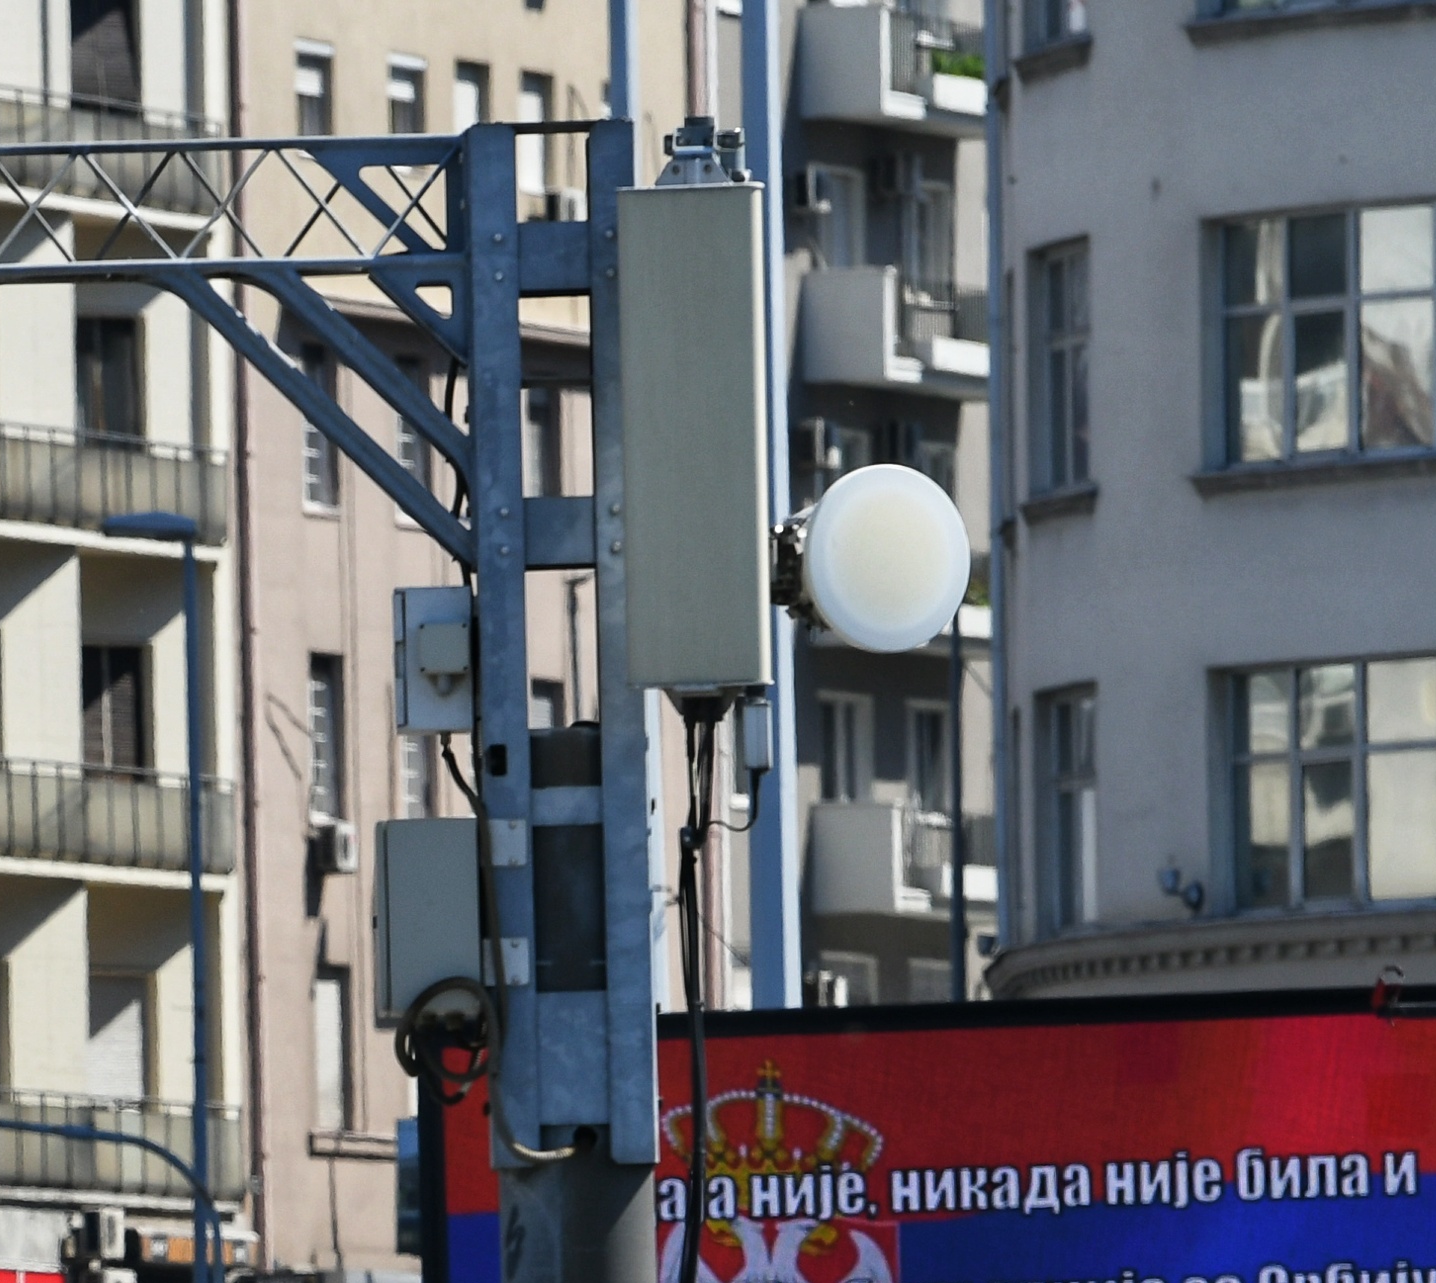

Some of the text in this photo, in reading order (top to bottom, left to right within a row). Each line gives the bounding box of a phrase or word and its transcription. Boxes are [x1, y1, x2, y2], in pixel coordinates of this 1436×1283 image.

[750, 1163, 876, 1220] није,
[890, 1163, 1092, 1215] никада
[1105, 1151, 1223, 1208] није
[1236, 1147, 1371, 1200] била
[1384, 1151, 1418, 1197] и
